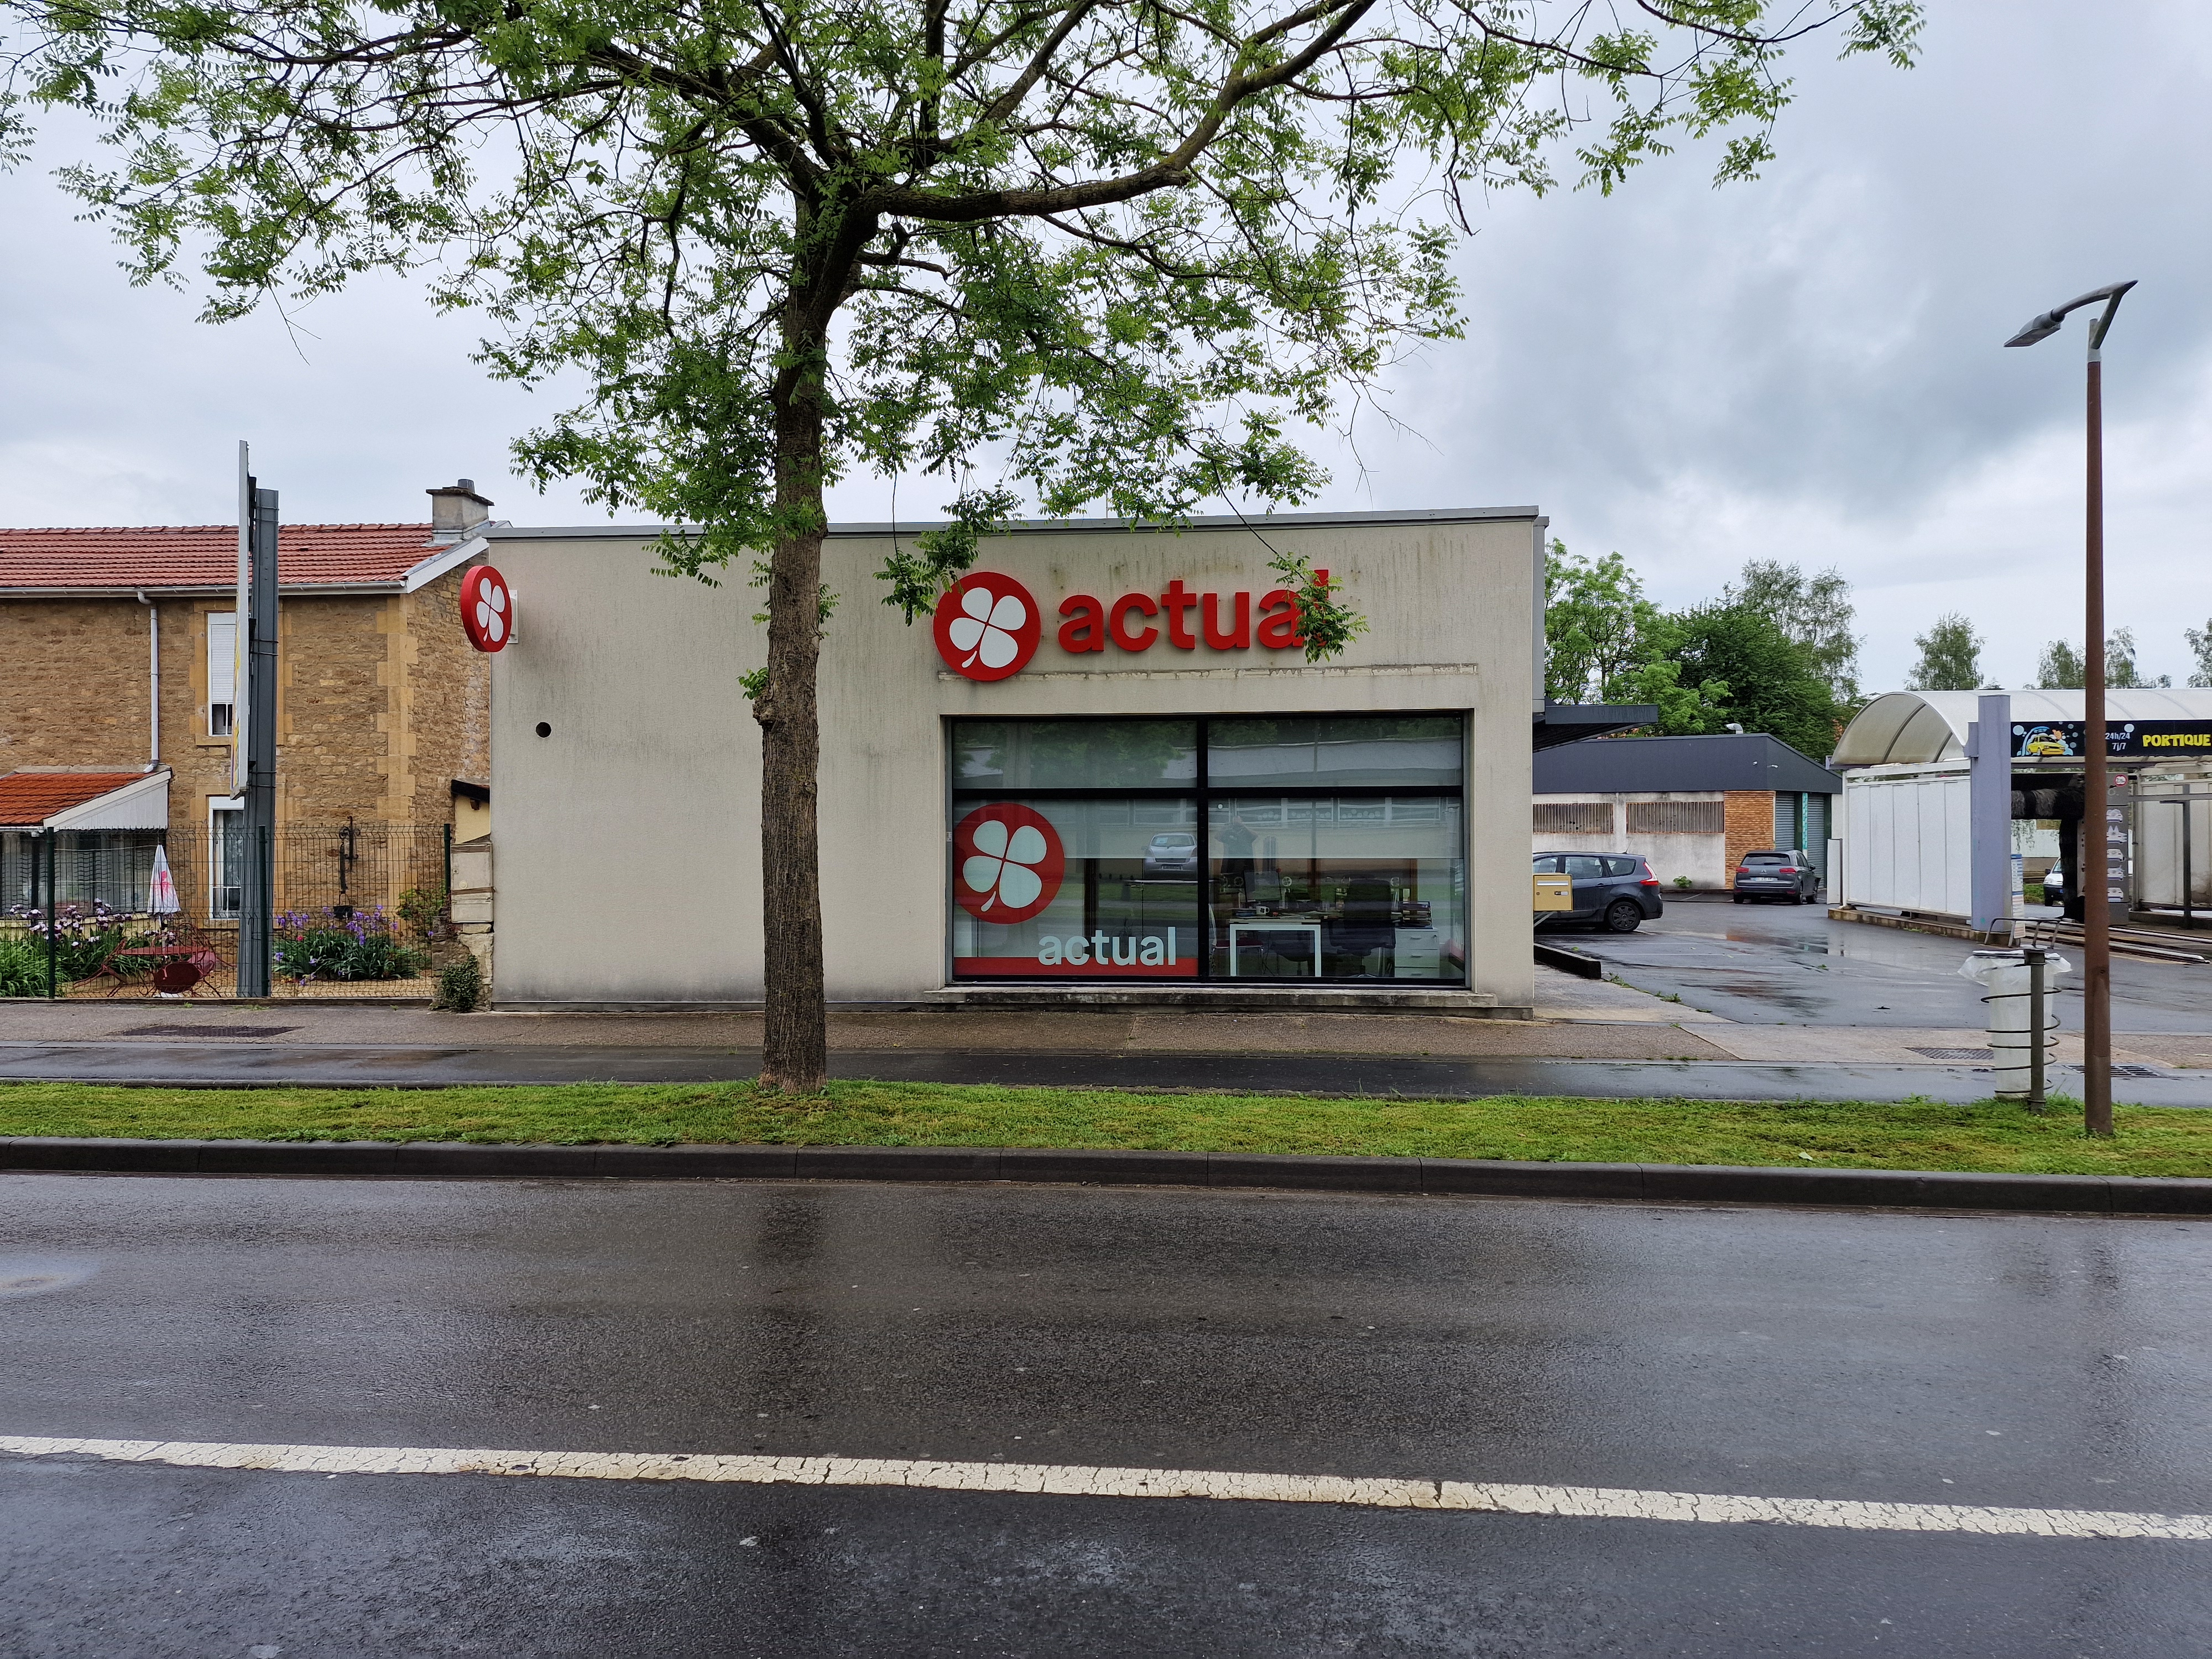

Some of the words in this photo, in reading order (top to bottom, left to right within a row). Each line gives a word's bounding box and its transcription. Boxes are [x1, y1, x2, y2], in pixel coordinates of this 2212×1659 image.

[2112, 742, 2126, 751] 7j/7
[2142, 734, 2211, 747] PORTIQUE
[1038, 926, 1176, 966] actual
